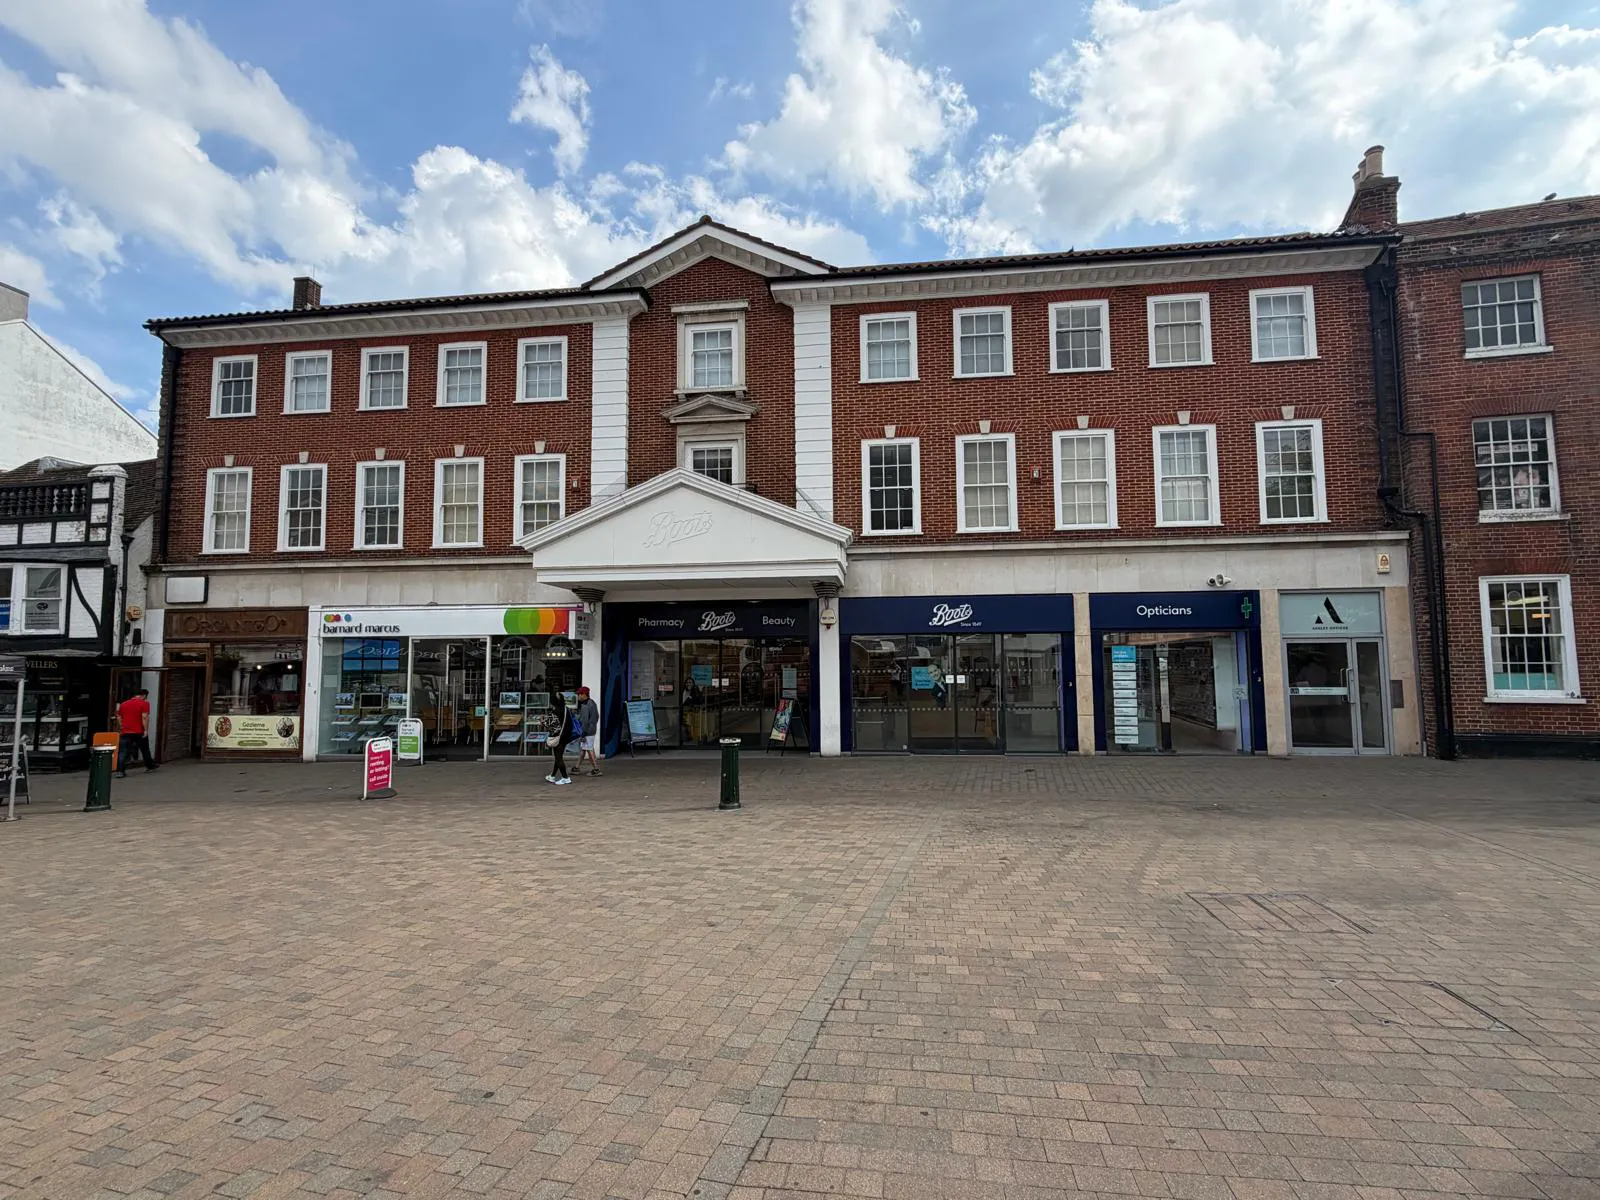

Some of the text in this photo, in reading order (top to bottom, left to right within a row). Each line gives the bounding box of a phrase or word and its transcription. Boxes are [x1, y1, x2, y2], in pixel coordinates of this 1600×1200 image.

[642, 511, 713, 549] Boots
[928, 603, 973, 627] Boots
[1136, 605, 1193, 619] Opticians
[322, 623, 401, 634] barnard marcus
[638, 617, 685, 628] Pharmacy
[697, 611, 736, 632] Boots
[762, 615, 796, 628] Beauty
